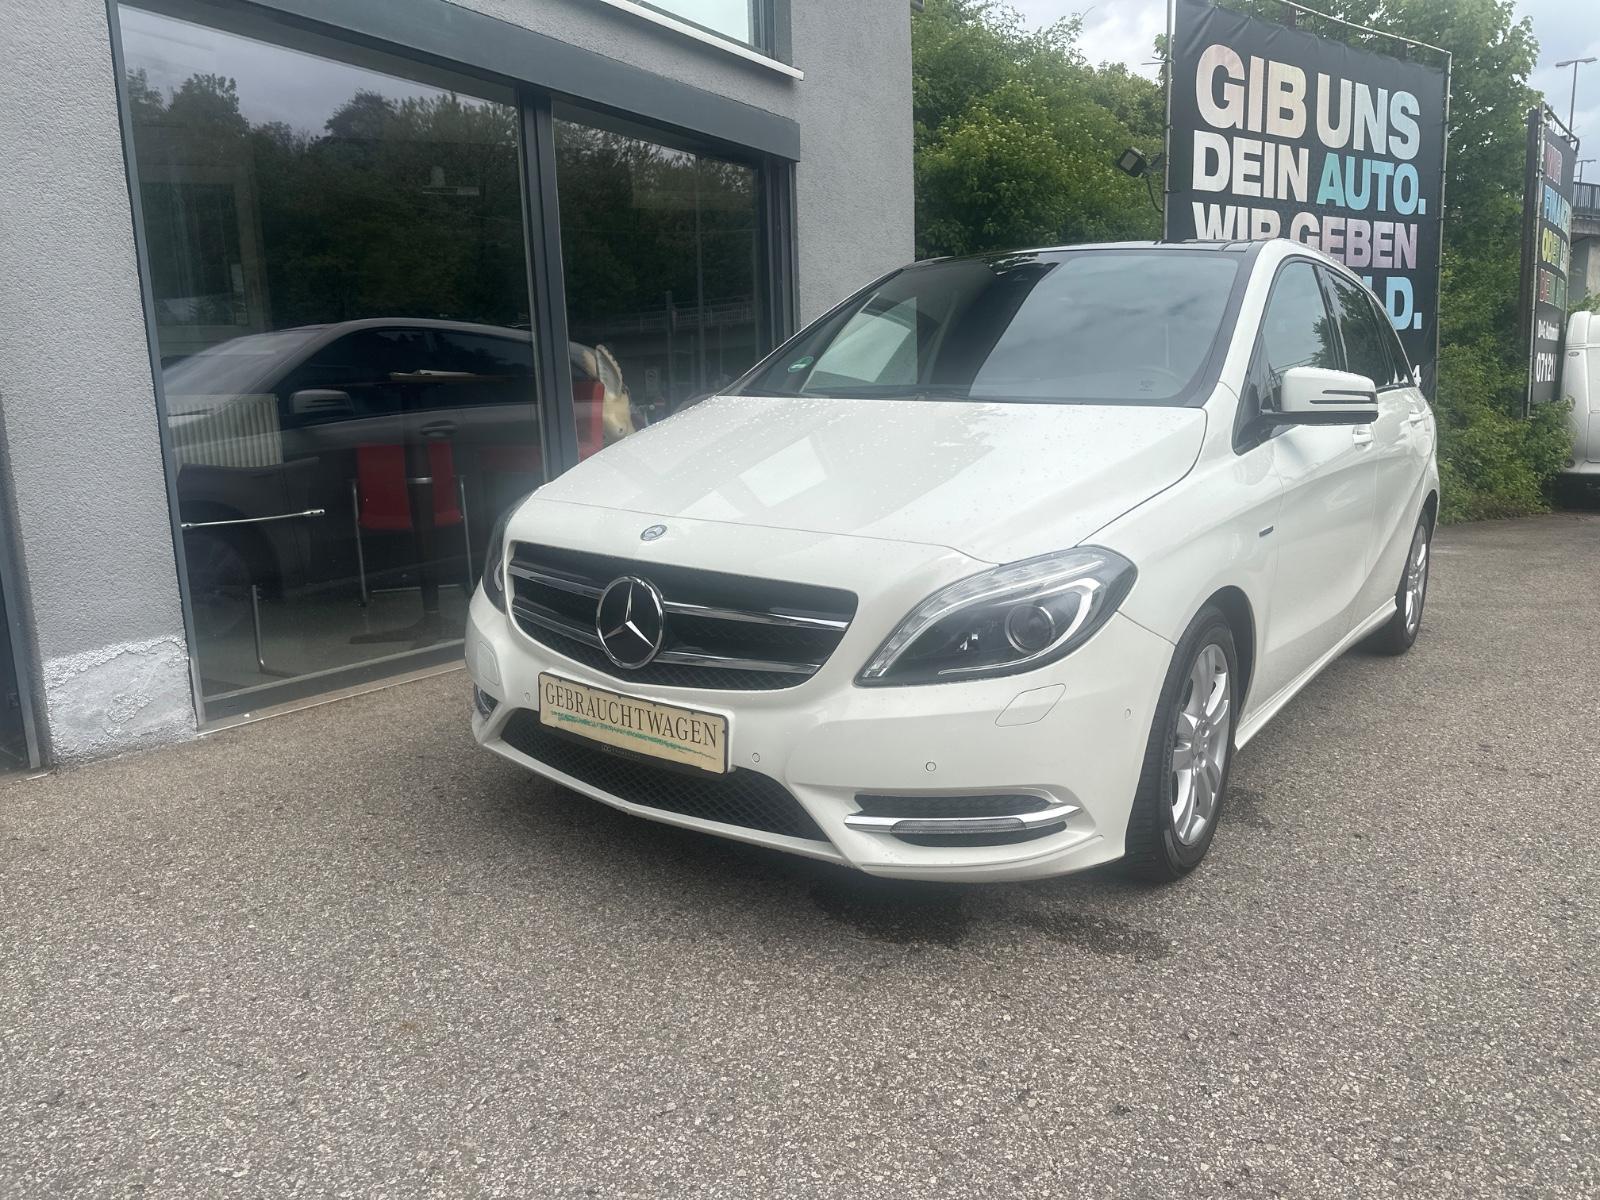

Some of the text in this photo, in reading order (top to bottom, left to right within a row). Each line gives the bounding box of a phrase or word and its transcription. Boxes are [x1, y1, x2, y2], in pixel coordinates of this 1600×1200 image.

[1195, 43, 1421, 160] GIB UNS
[1192, 129, 1426, 216] DEIN AUTO.
[1289, 211, 1418, 269] GEBEN
[545, 682, 717, 748] GEBRAUCHTWAGEN
